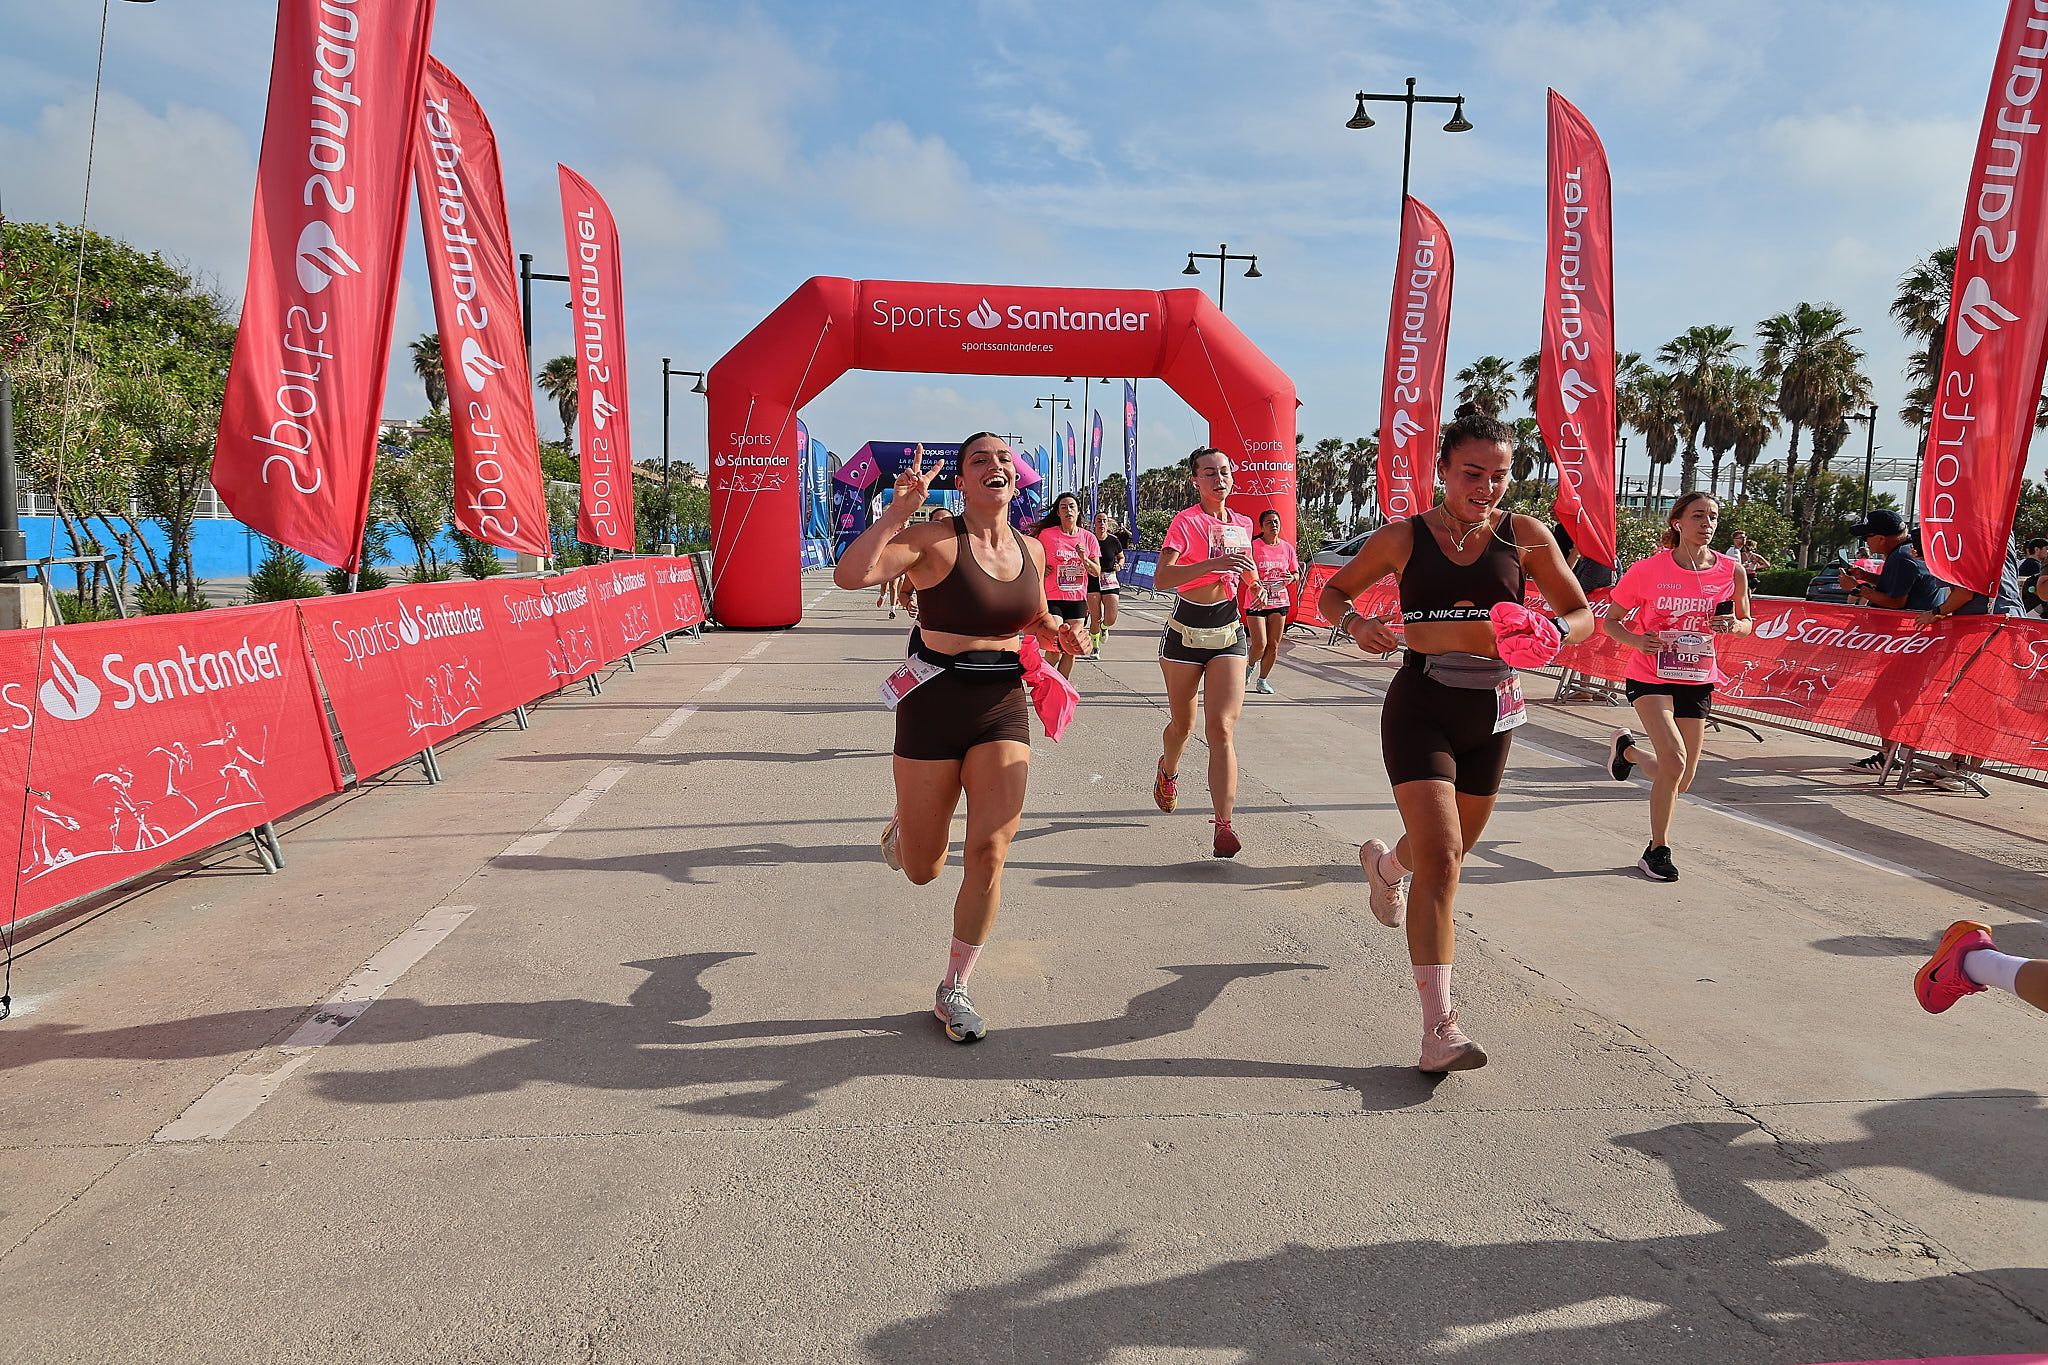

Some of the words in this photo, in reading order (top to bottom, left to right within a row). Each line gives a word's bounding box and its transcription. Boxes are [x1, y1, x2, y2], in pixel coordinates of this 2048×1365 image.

[872, 299, 961, 333] Sports
[1007, 304, 1149, 331] Santander
[961, 340, 1054, 353] sportssantander.es
[730, 432, 771, 447] Sports
[1245, 439, 1283, 453] Sports
[727, 454, 789, 466] Santander
[1241, 460, 1294, 471] Santander
[504, 594, 542, 630] Sports
[551, 585, 590, 613] Santander
[1656, 596, 1714, 612] CARRERA
[1428, 609, 1466, 619] NIKE
[1466, 609, 1490, 618] PR
[332, 619, 400, 671] Sports
[417, 602, 485, 642] Santander
[1785, 618, 1946, 656] Santander
[1677, 653, 1699, 663] 016
[102, 636, 282, 711] Santander
